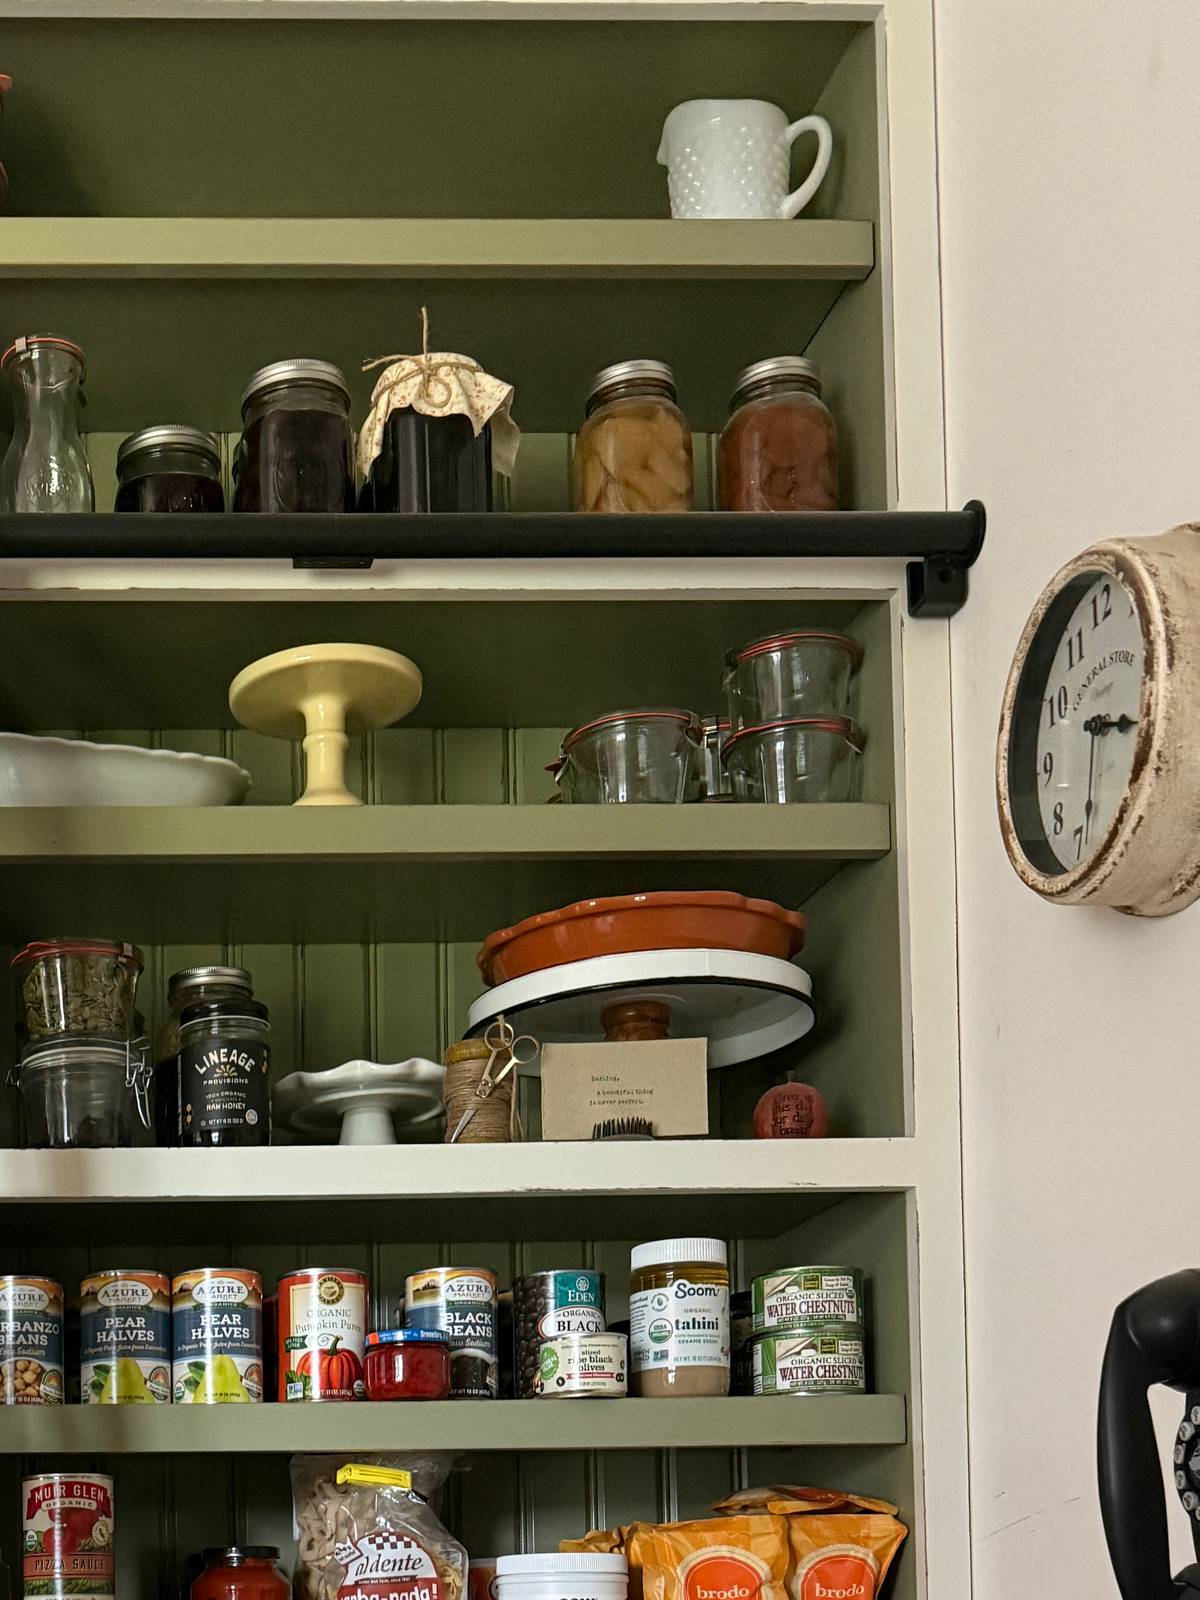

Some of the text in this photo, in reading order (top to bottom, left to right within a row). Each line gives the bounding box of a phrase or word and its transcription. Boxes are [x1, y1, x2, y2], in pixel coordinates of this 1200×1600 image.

[1091, 584, 1112, 631] 12
[1067, 627, 1084, 672] 11
[1109, 650, 1135, 667] STORE
[1049, 685, 1068, 729] 10
[1043, 752, 1054, 786] 9
[1053, 802, 1064, 836] 8
[1073, 826, 1085, 861] 7
[195, 1048, 256, 1074] LINEAGE
[203, 1078, 249, 1086] PROVISIONS
[222, 1102, 246, 1110] HONEY
[102, 1289, 149, 1298] AZURE
[197, 1285, 244, 1295] AZURE
[446, 1284, 490, 1293] AZURE
[675, 1282, 719, 1299] Soom
[0, 1293, 46, 1302] AZURE
[568, 1290, 595, 1302] EDEN
[776, 1292, 844, 1303] ORGANIC SLICED
[562, 1309, 598, 1319] ORGANIC
[767, 1300, 855, 1318] WATER CHESTNUTS
[105, 1317, 146, 1328] PEAR
[200, 1314, 241, 1326] PEAR
[445, 1313, 491, 1324] BLACK
[675, 1317, 719, 1330] tahini
[445, 1325, 492, 1337] BEANS
[557, 1320, 601, 1332] BLACK
[97, 1330, 155, 1343] HALVES
[192, 1327, 250, 1340] HALVES
[465, 1338, 491, 1347] Sodium
[17, 1347, 46, 1356] Sodium
[589, 1355, 613, 1364] black
[791, 1357, 832, 1366] ORGANIC
[779, 1366, 814, 1382] WATER
[35, 1484, 104, 1503] MUIR GLEN
[72, 1559, 105, 1570] SAUCE
[696, 1585, 750, 1600] brodo
[815, 1583, 865, 1599] brodo
